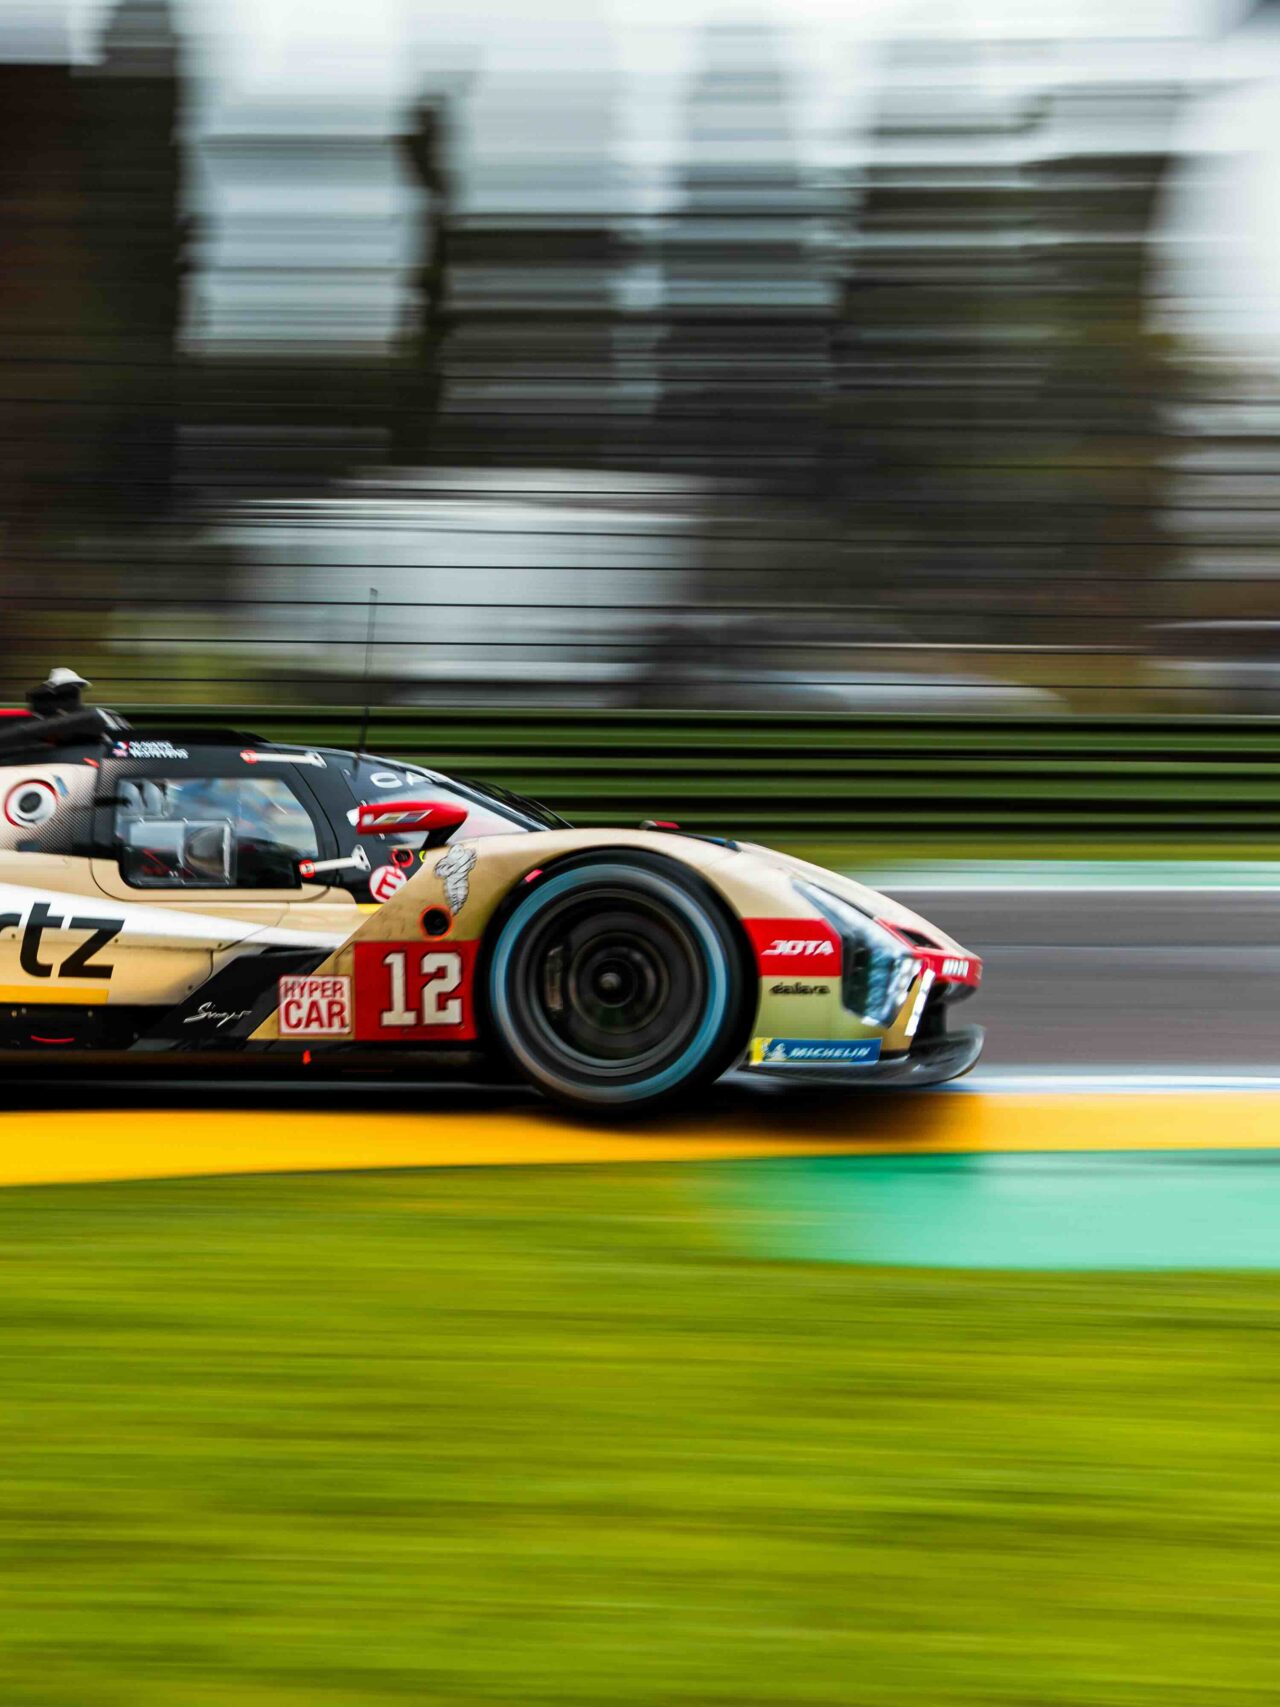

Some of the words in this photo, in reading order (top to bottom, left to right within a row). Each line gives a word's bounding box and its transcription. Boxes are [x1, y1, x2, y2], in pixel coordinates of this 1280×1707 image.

[761, 940, 835, 956] JOTA
[283, 980, 345, 998] HYPER
[380, 952, 463, 1027] 12
[284, 999, 346, 1029] CAR
[787, 1046, 872, 1058] MICHELIN
